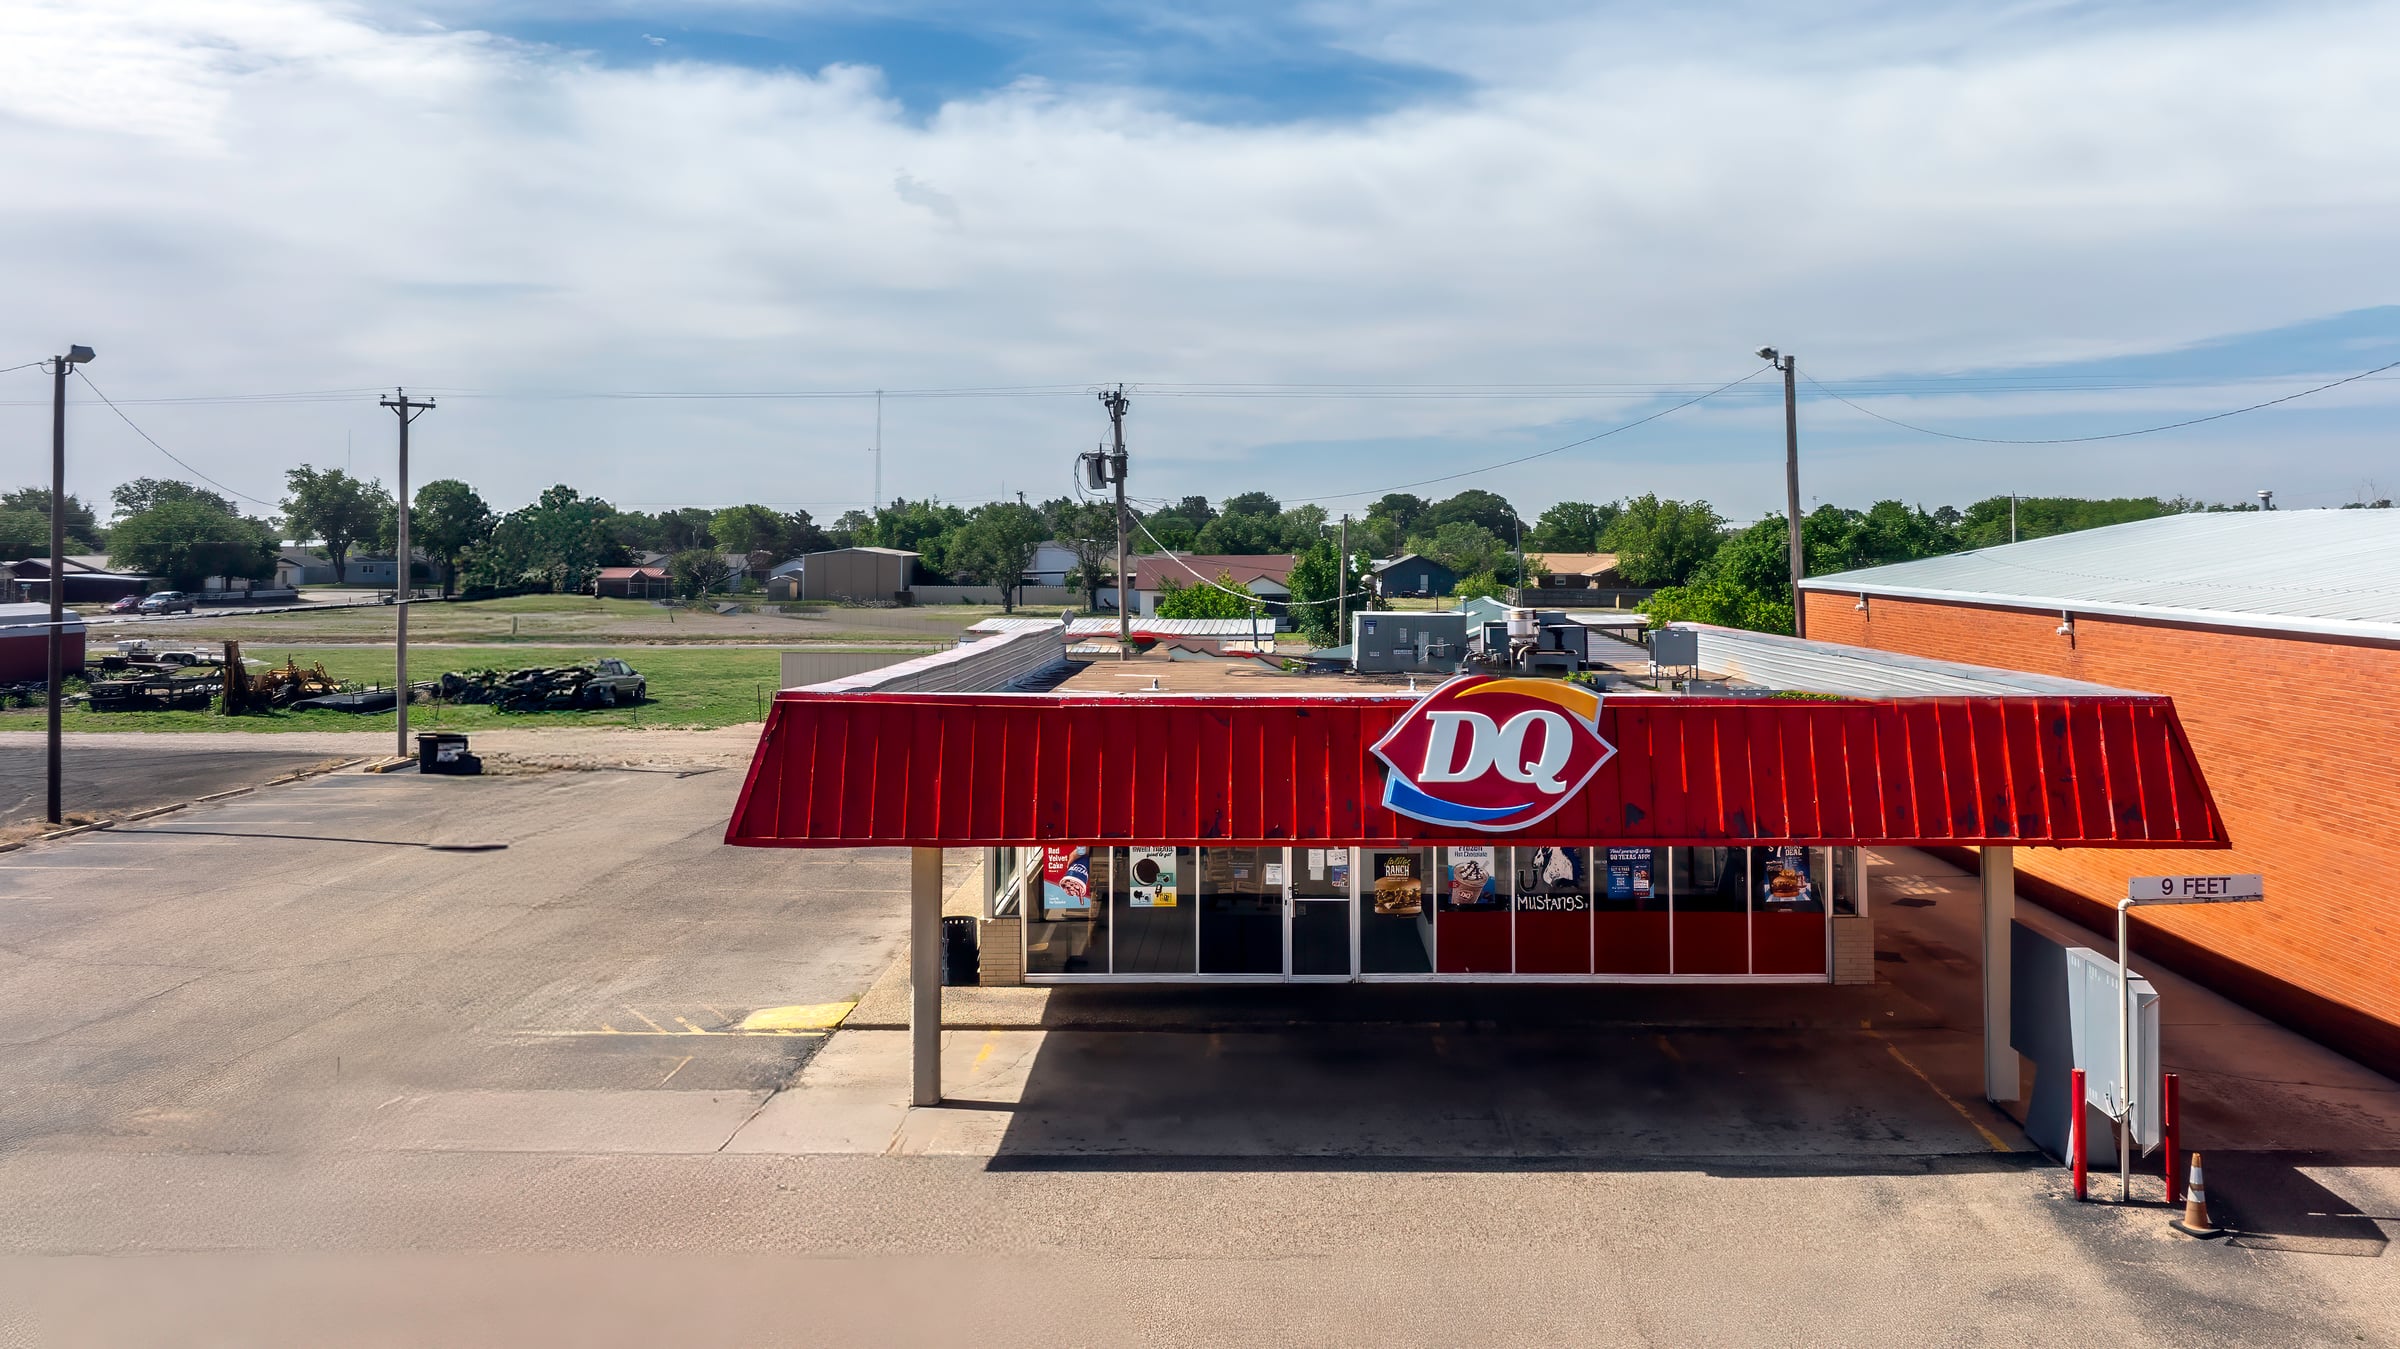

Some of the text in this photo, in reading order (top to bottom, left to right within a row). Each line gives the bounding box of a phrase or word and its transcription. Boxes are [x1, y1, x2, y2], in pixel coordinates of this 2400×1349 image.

[1417, 709, 1573, 795] DQ
[1385, 864, 1410, 877] RANCH
[2161, 877, 2231, 896] 9 FEET
